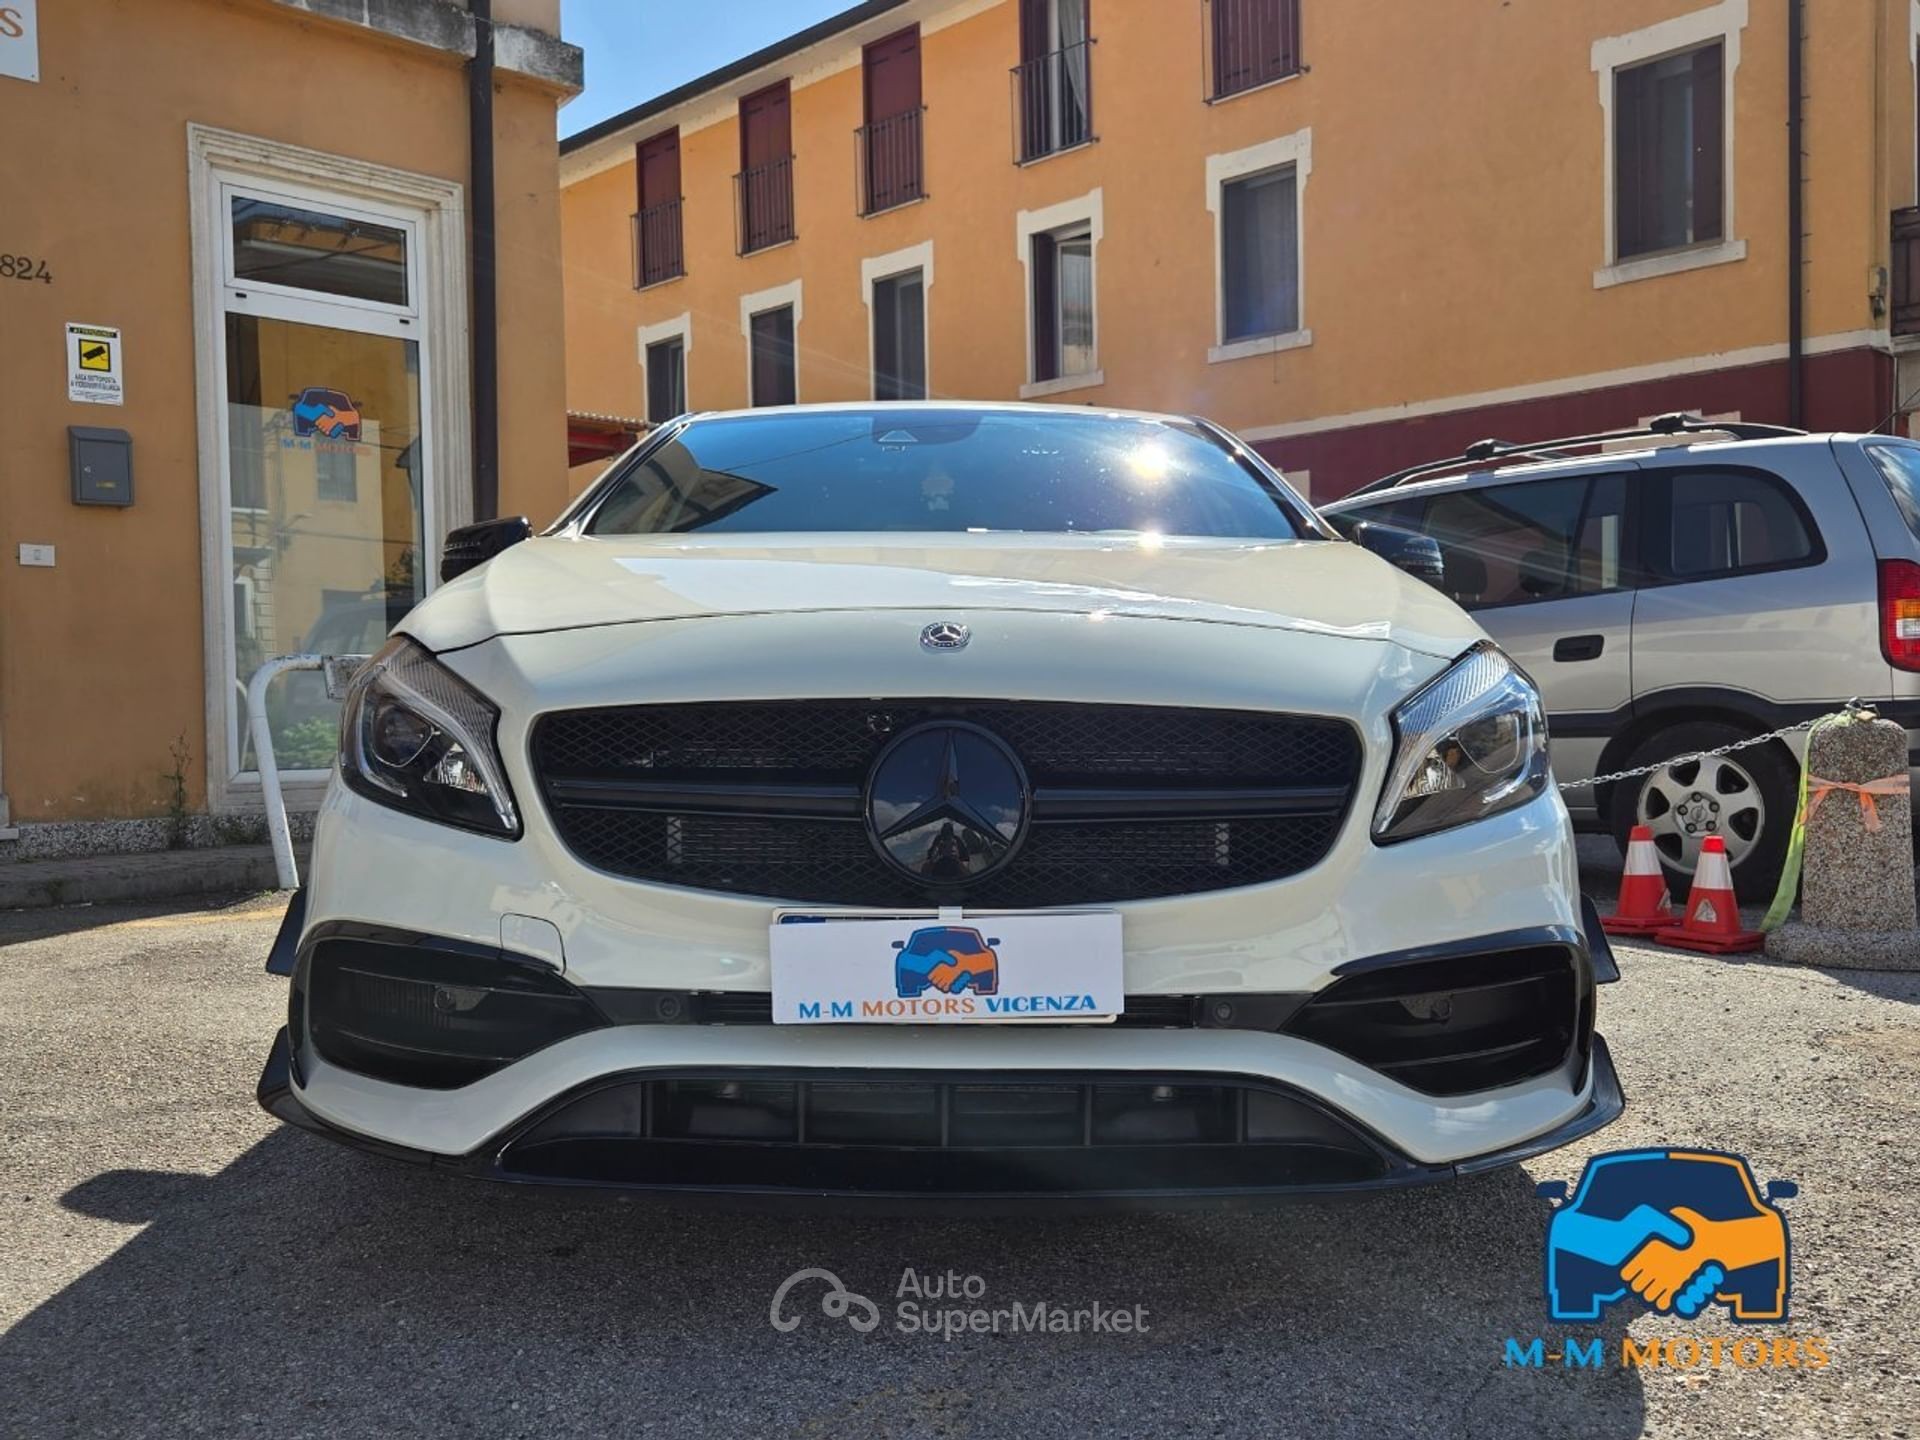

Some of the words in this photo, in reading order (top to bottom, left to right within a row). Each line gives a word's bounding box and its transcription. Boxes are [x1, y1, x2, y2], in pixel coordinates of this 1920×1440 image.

[799, 1001, 852, 1018] M-M
[862, 998, 975, 1016] MOTORS
[985, 994, 1096, 1012] VICENZA
